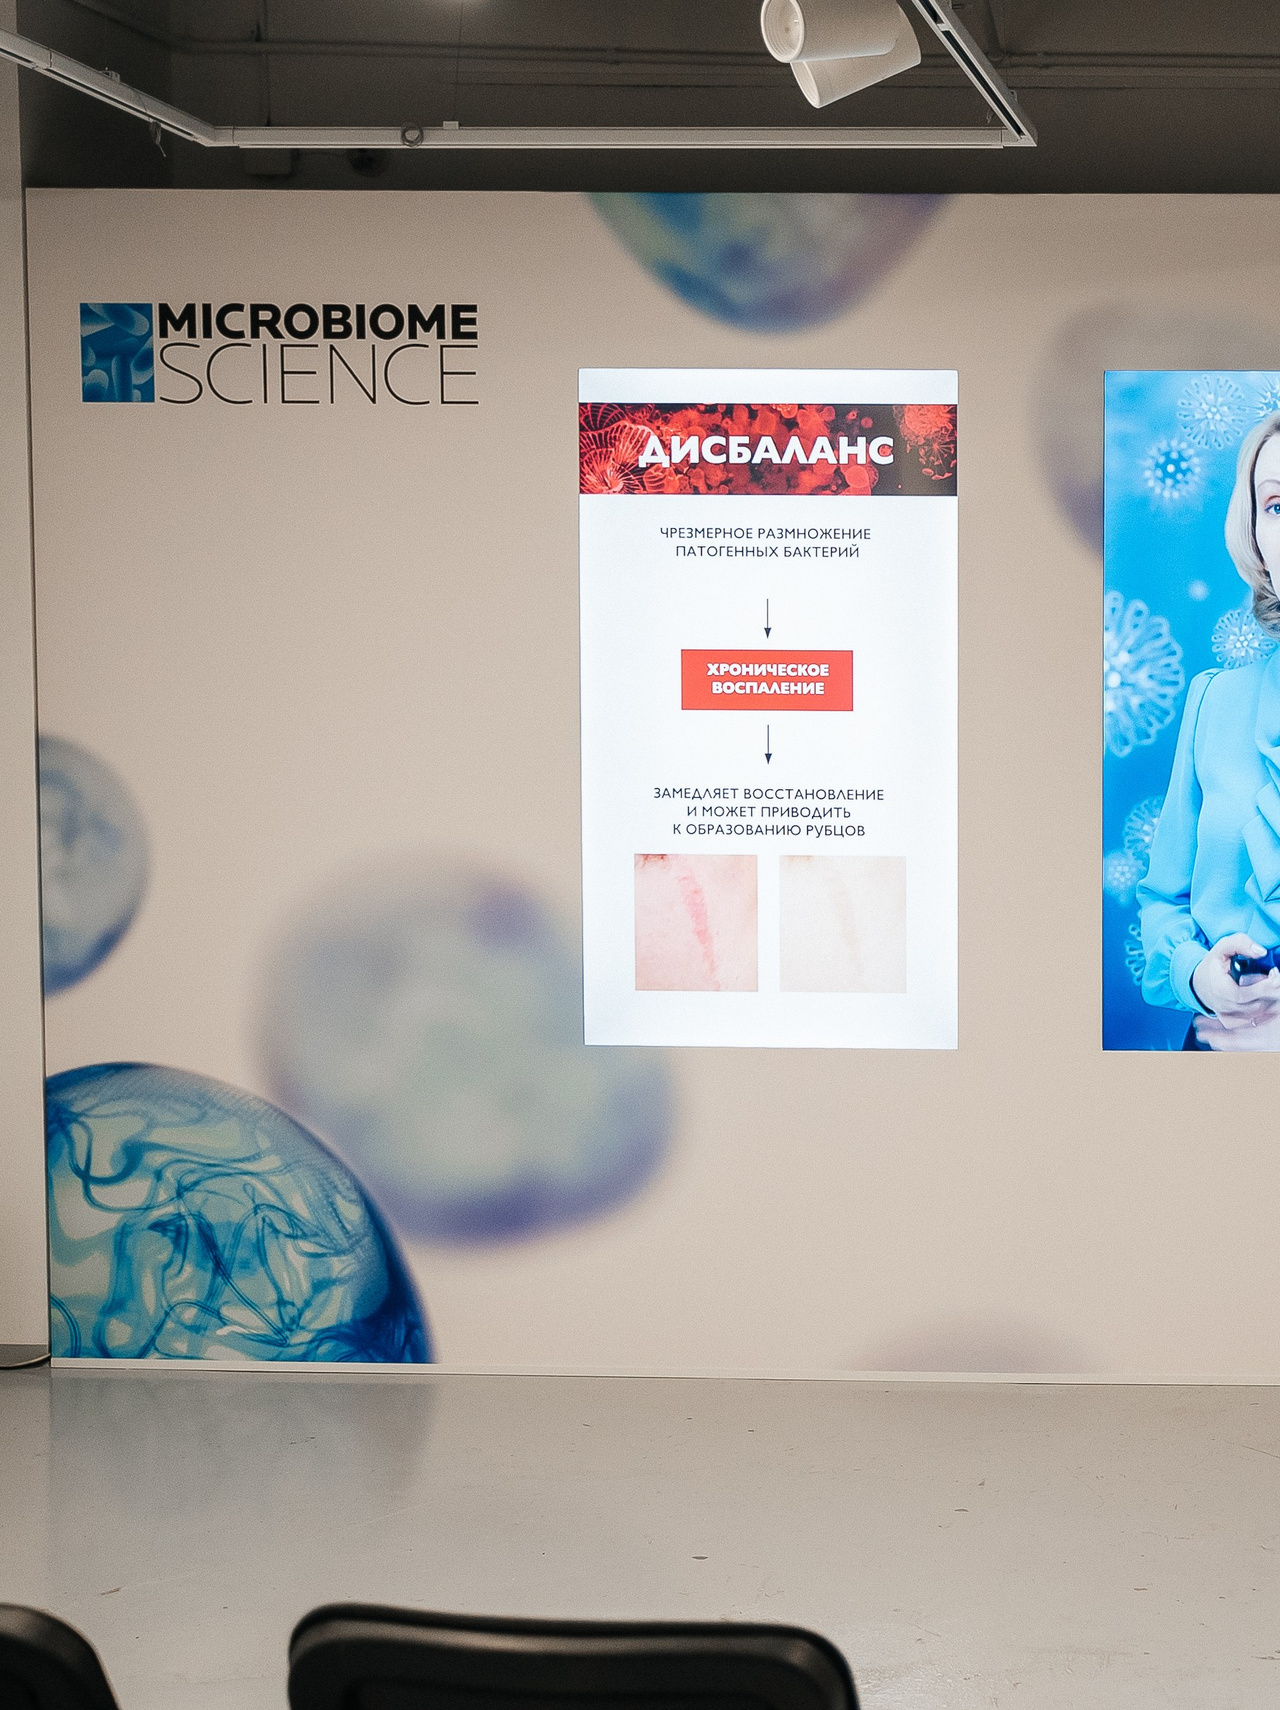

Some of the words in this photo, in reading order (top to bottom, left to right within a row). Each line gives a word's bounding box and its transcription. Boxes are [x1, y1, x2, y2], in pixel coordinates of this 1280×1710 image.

[158, 303, 479, 340] MICROBIOME
[159, 342, 479, 405] SCIENCE
[638, 435, 894, 468] ДИСБАЛАНС
[660, 527, 753, 540] ЧРЕЗМЕРНОЕ
[757, 527, 871, 540] РАЗМНОЖЕНИЕ
[675, 545, 779, 558] ПАТОГЕННЫХ
[783, 543, 860, 558] БАКТЕРИЙ
[706, 662, 830, 677] ХРОНИЧЕСКОЕ
[712, 682, 825, 695] ВОСПАЛЕНИЕ
[653, 787, 739, 801] ЗАМЕДЛЯЕТ
[743, 788, 884, 801] ВОССТАНОВЛЕНИЕ
[687, 806, 698, 818] И
[701, 806, 756, 818] МОЖЕТ
[760, 806, 851, 820] ПРИВОДИТЬ
[672, 824, 682, 835] К
[686, 823, 802, 836] ОБРАЗОВАНИЮ
[806, 824, 866, 838] РУБЦОВ
